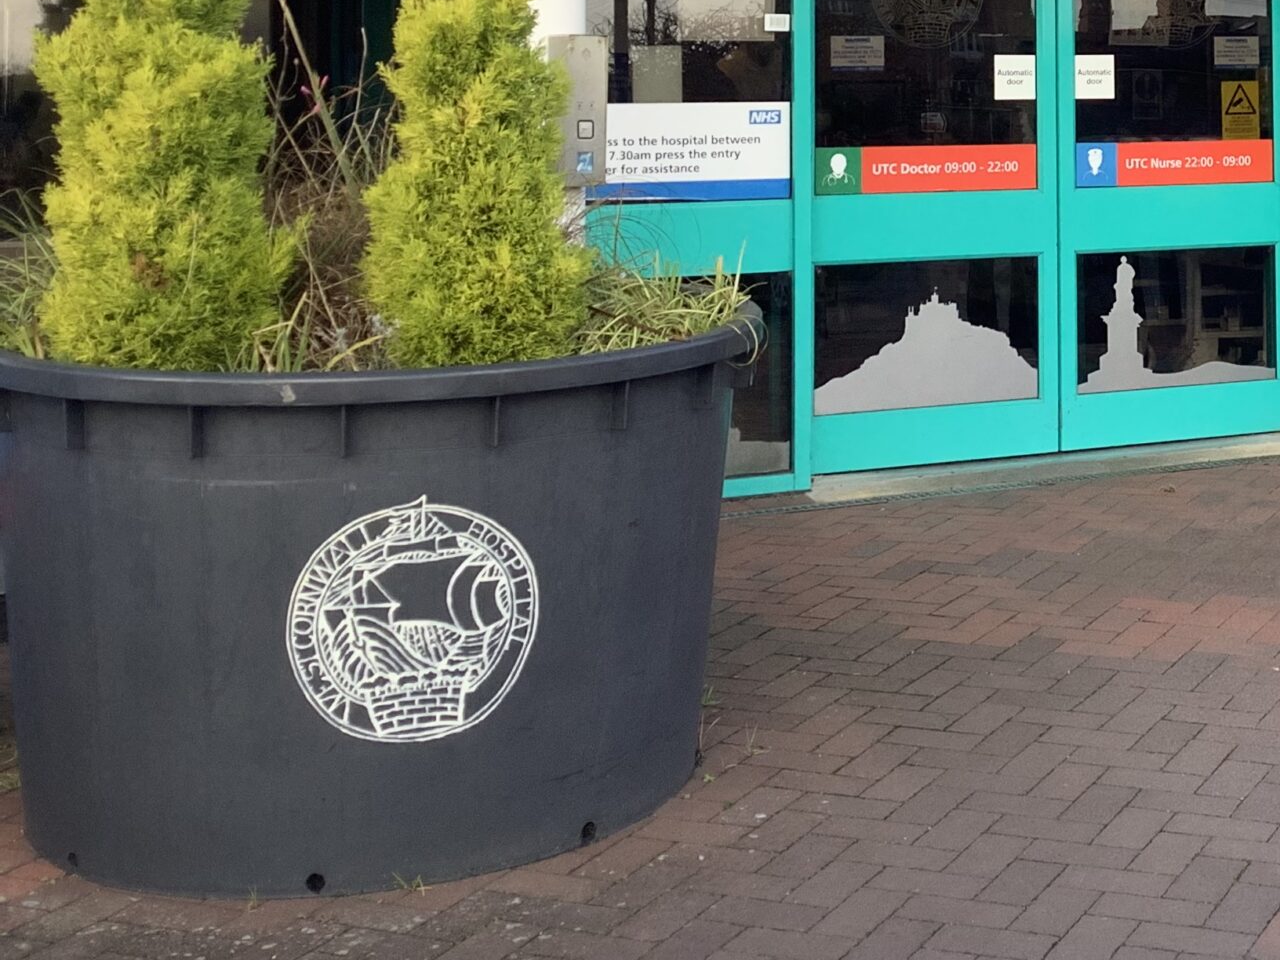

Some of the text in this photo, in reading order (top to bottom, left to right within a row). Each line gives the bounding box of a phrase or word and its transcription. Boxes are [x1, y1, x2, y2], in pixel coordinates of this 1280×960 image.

[997, 69, 1033, 77] Automatic
[1077, 69, 1112, 77] Automatic
[750, 111, 780, 123] NHS
[623, 137, 635, 147] to
[639, 136, 658, 146] the
[661, 135, 707, 147] hospital
[711, 135, 761, 145] between
[609, 149, 741, 162] 7.30am press the entry
[872, 163, 897, 175] UTC
[900, 162, 941, 174] Doctor
[944, 161, 977, 173] 09:00
[987, 160, 1019, 172] 22:00
[1125, 158, 1148, 169] UTC
[1150, 157, 1182, 169] Nurse
[1185, 157, 1213, 167] 22:00
[1223, 155, 1251, 166] 09:00
[621, 164, 638, 174] for
[641, 163, 700, 174] assistance
[294, 519, 532, 724] WEST CORNWALL HOSPITAL
